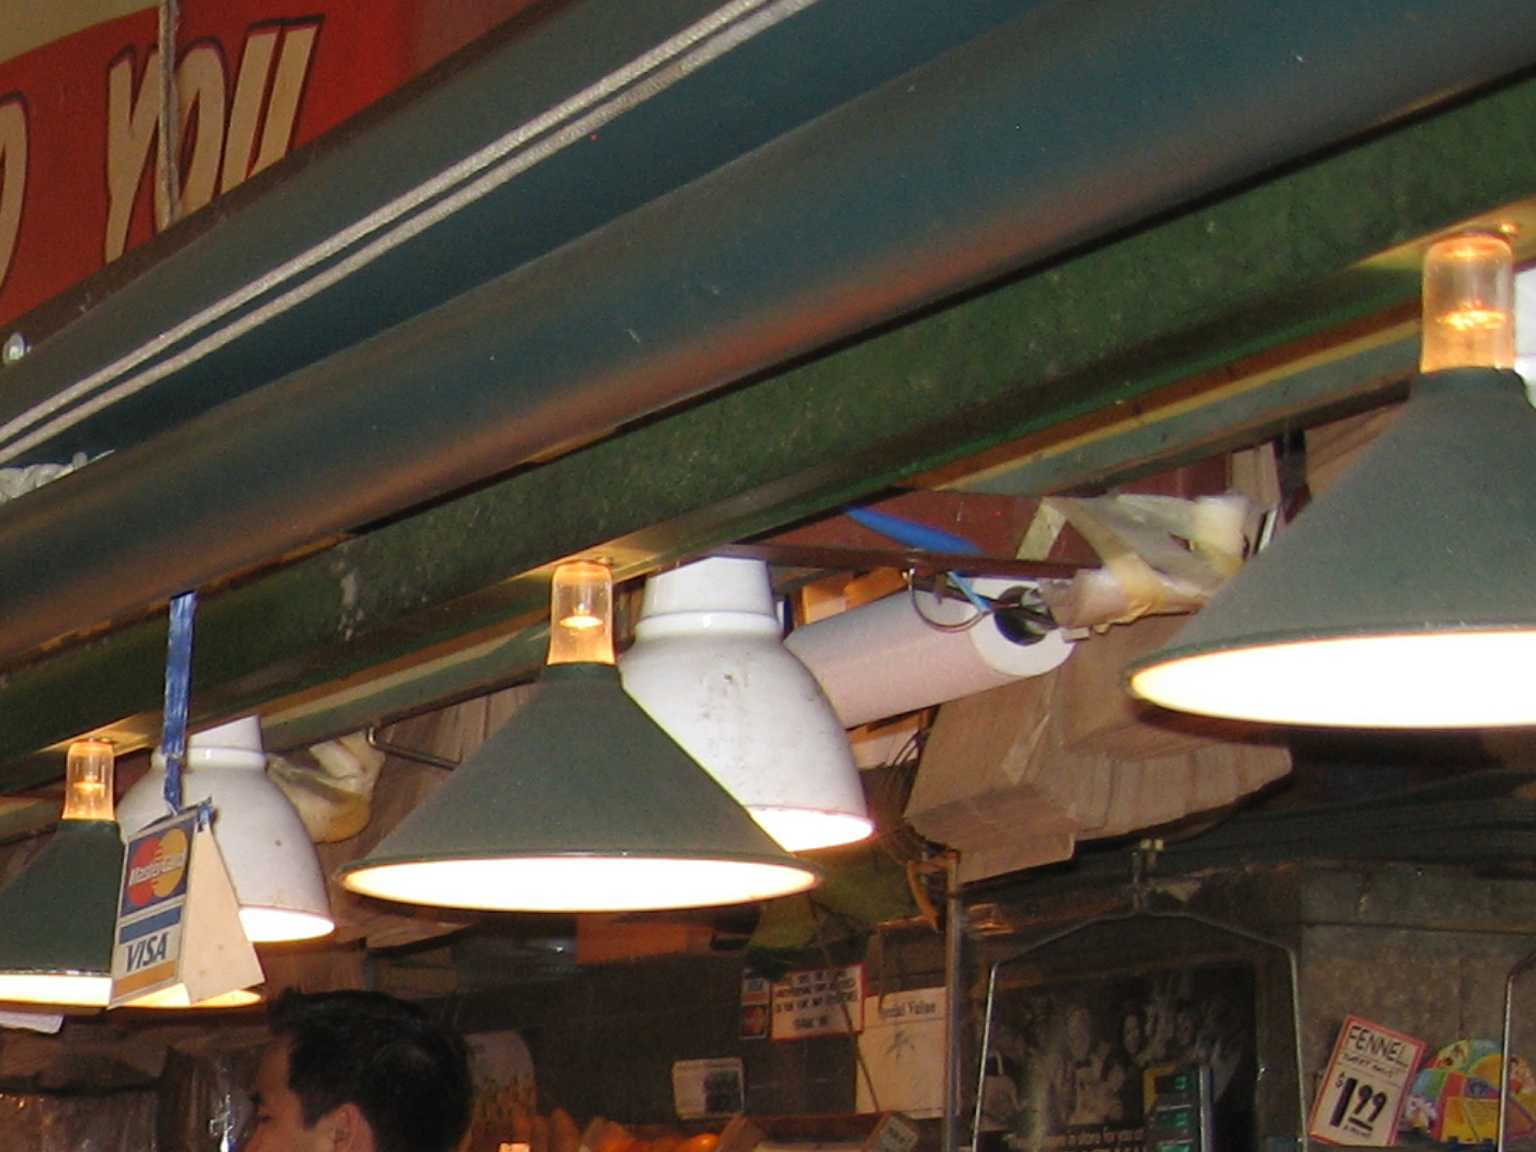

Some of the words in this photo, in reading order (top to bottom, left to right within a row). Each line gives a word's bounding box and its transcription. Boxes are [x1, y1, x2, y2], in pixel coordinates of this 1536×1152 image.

[104, 13, 326, 267] YOU
[126, 931, 169, 972] VISA
[1348, 1025, 1409, 1068] FENNEL
